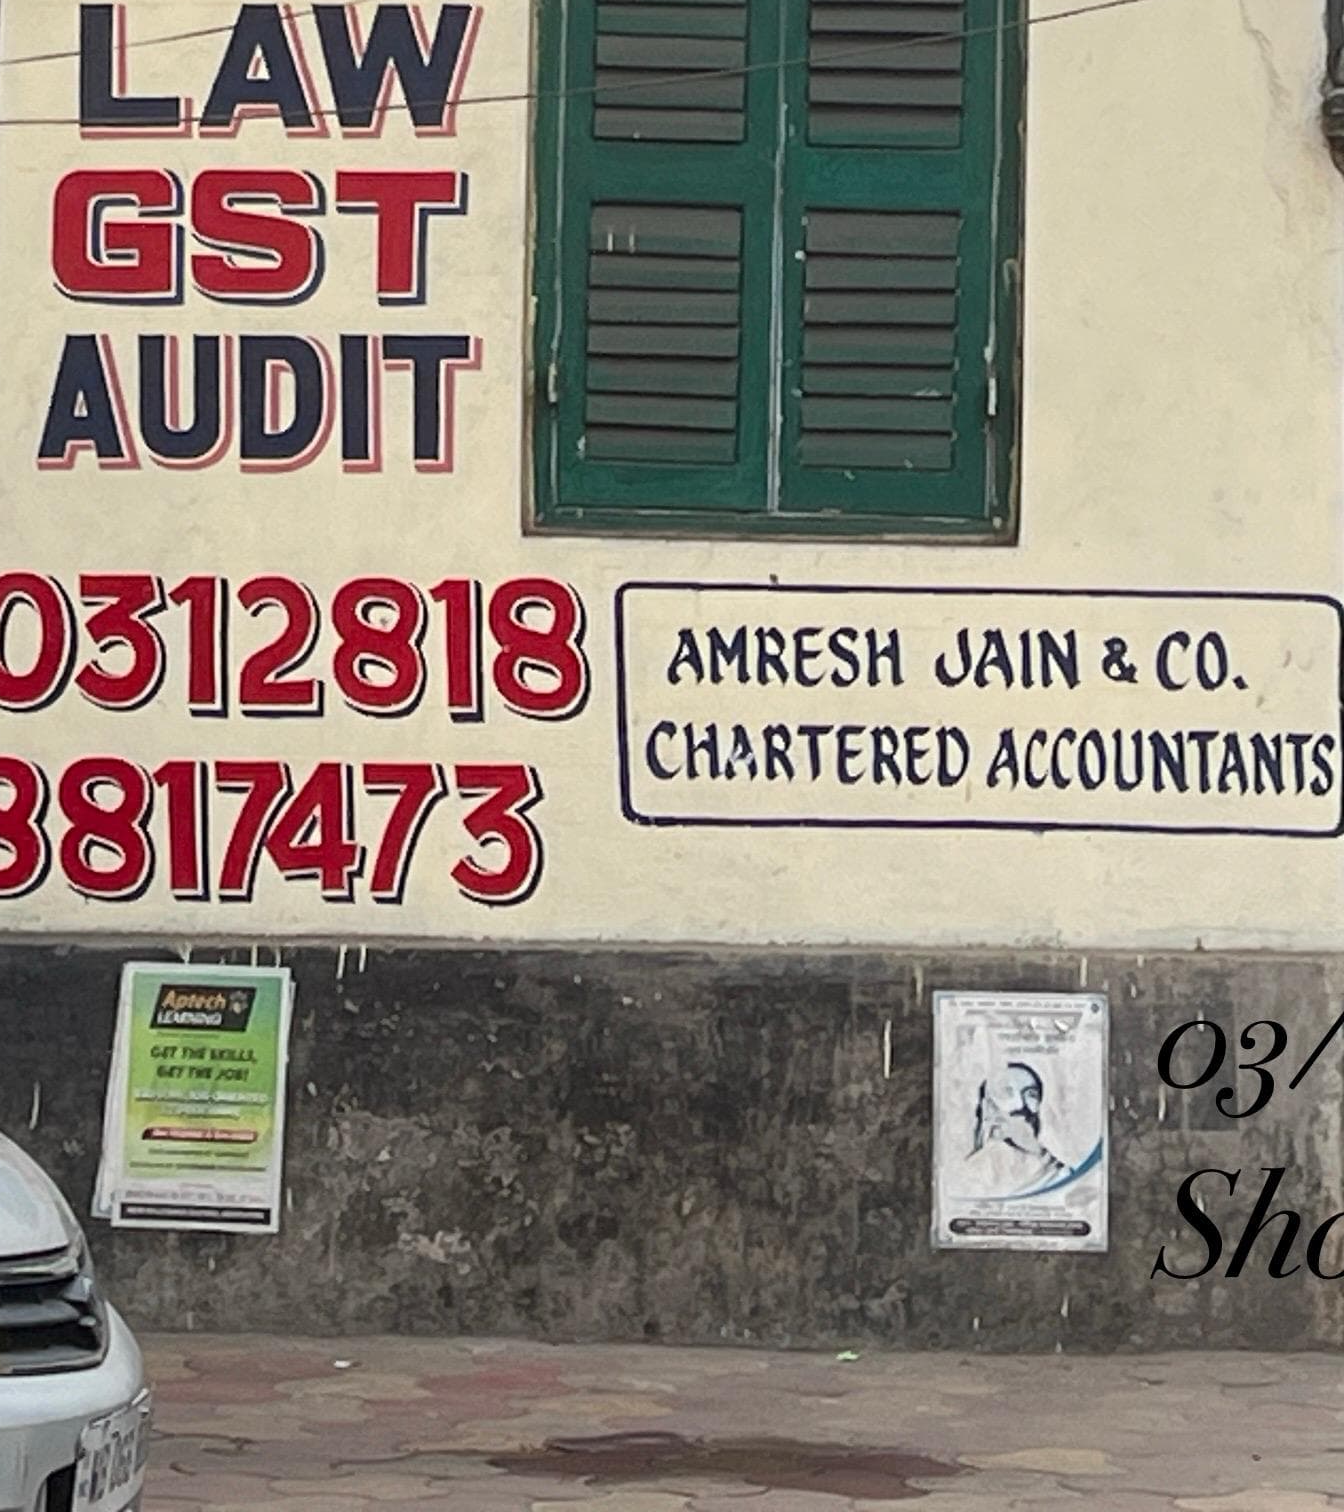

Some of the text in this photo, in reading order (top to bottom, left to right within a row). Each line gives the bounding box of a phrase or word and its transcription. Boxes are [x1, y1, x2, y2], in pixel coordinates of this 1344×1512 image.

[79, 3, 484, 139] LAW
[51, 169, 469, 307] GST
[37, 333, 484, 474] AUDIT
[666, 625, 1249, 691] AMRESH JAIN & CO.
[645, 720, 1336, 797] CHARTERED ACCOUNTANTS
